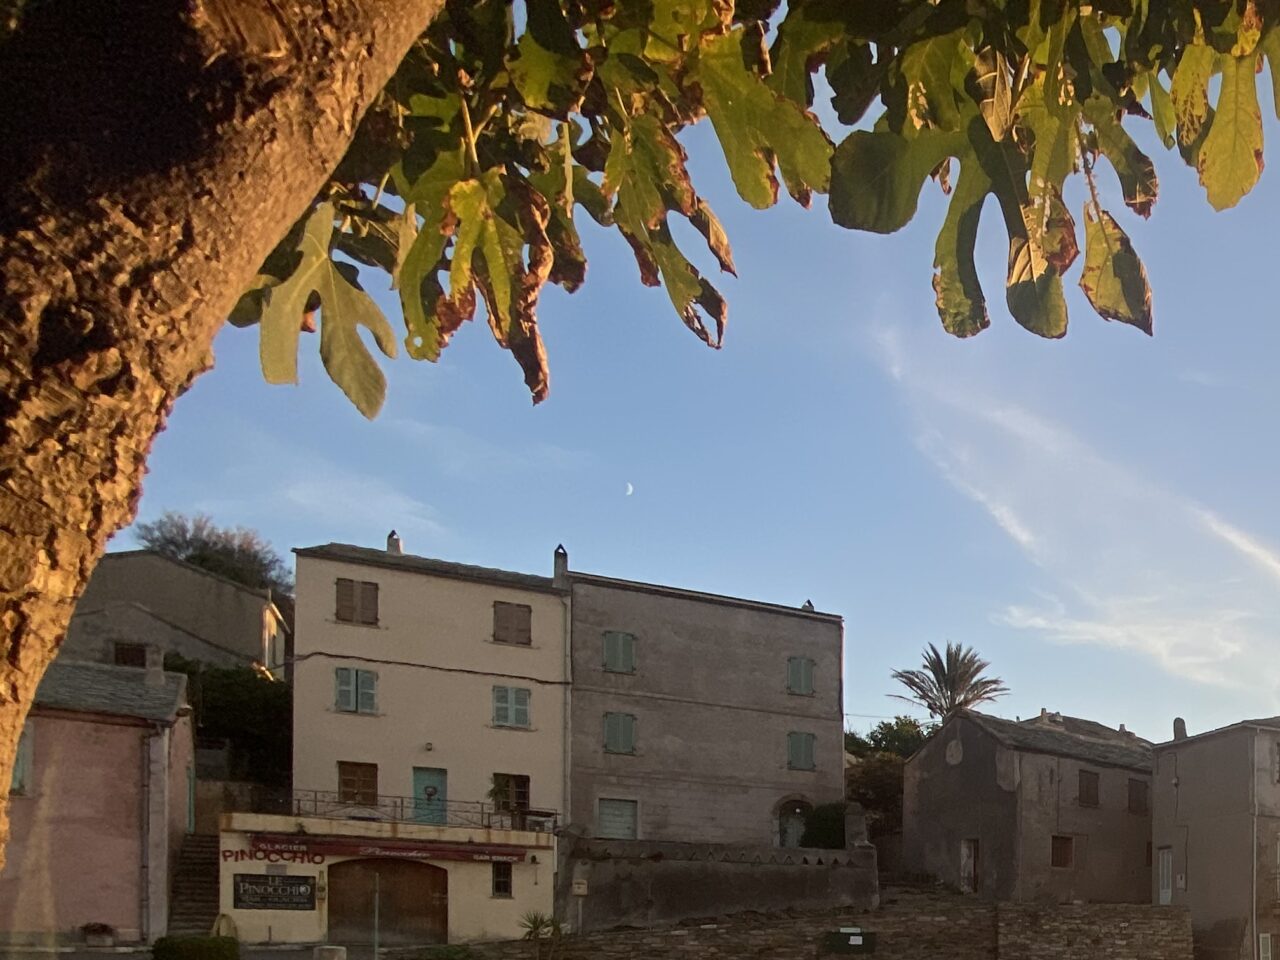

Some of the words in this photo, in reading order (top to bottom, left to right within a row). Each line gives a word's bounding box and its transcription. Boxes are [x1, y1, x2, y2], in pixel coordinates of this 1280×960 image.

[259, 843, 307, 851] GLACIER
[222, 849, 325, 864] PINOCCHIO
[268, 876, 282, 885] LE
[240, 882, 311, 897] PINOCCHIO
